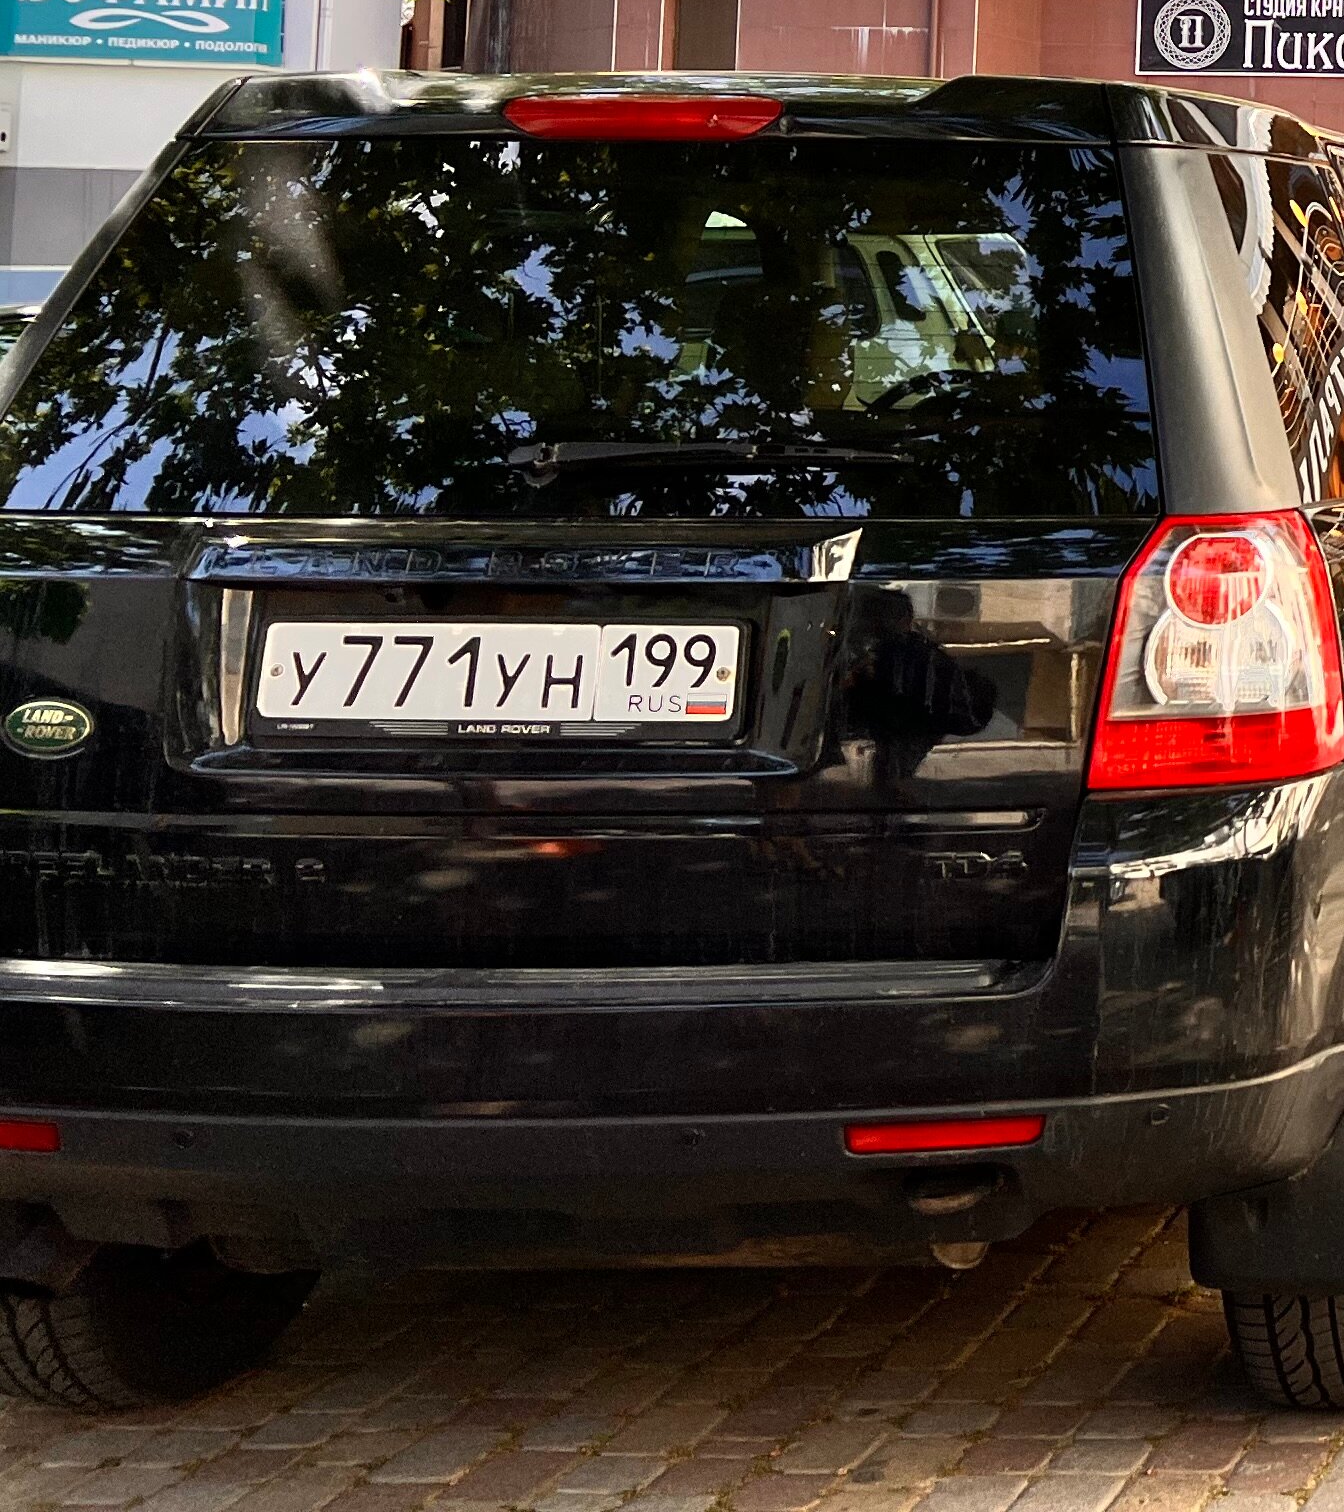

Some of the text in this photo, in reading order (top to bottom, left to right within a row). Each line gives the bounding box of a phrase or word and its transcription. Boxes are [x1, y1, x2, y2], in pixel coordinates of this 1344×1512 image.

[14, 33, 92, 47] МАНИКЮР
[107, 36, 180, 50] ПЕДИКЮР
[290, 633, 717, 708] У771УН 199
[627, 694, 683, 714] RUS
[457, 724, 550, 735] LAND ROVER
